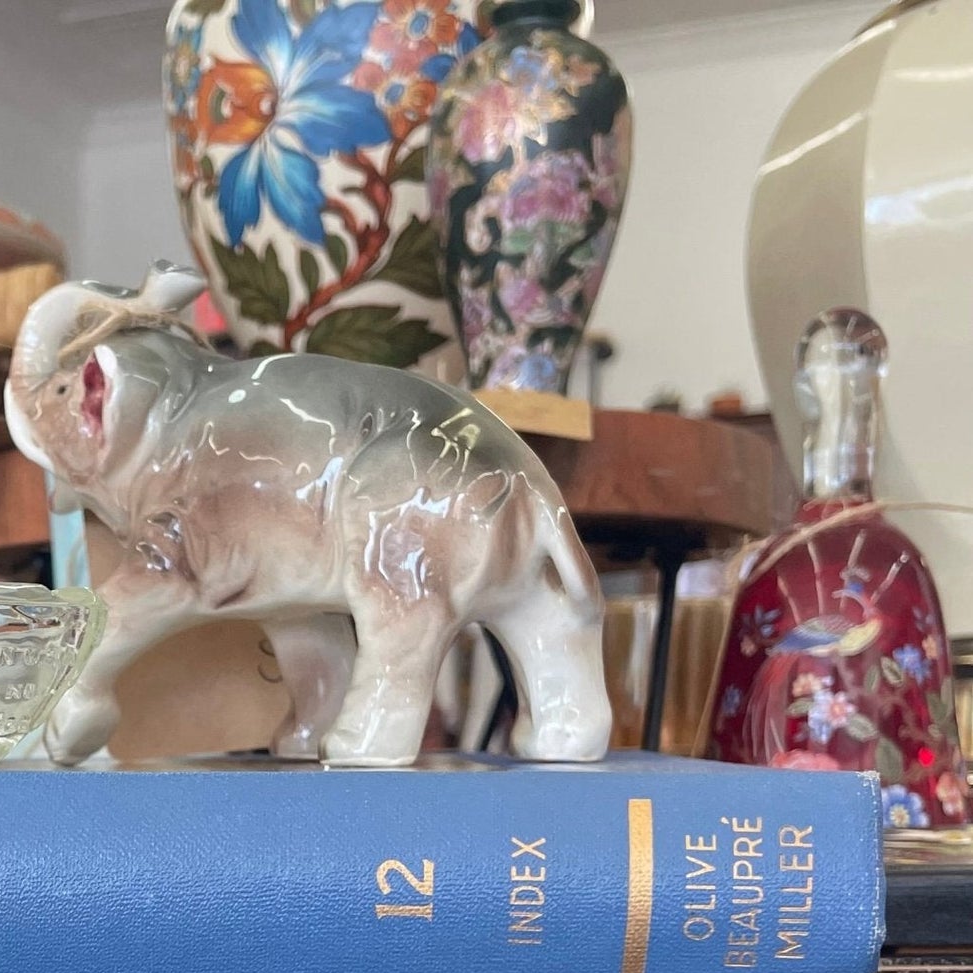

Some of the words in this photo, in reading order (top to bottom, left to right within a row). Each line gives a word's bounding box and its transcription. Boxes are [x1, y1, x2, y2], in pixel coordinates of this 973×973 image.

[375, 858, 435, 921] 12
[508, 836, 547, 946] INDEX
[683, 834, 717, 940] OLIVE
[721, 815, 762, 968] BEAUPRÉ
[775, 825, 813, 960] MILLER
